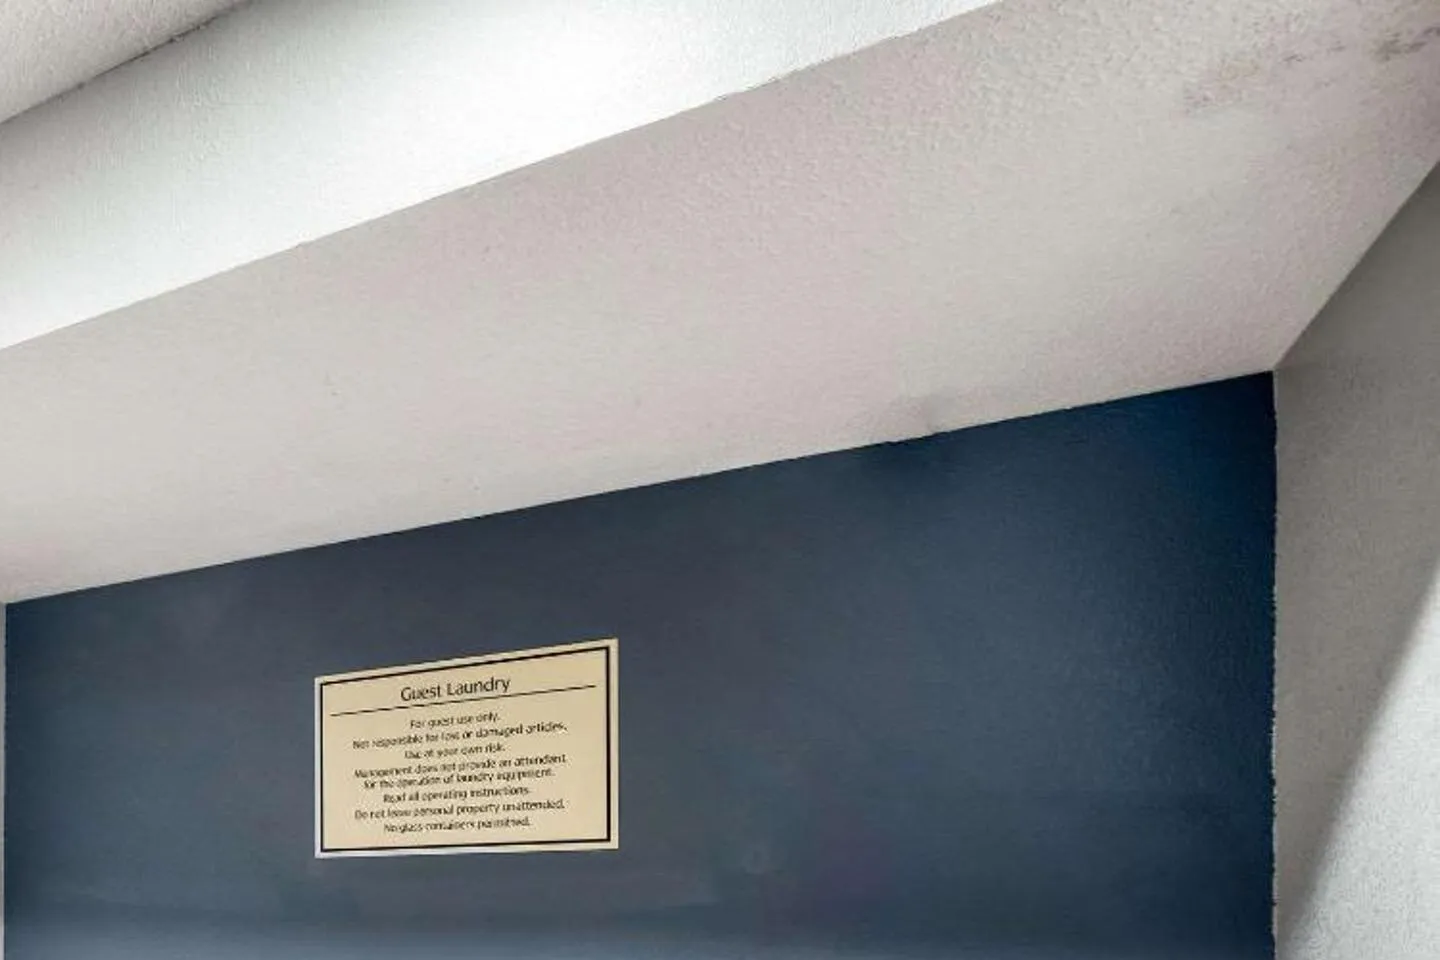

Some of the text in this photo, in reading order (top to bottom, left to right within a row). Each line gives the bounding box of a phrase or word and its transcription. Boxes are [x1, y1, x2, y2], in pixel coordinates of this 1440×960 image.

[400, 676, 511, 701] Guest Laundry
[427, 716, 454, 729] guest
[456, 714, 474, 725] use
[372, 734, 423, 748] responsible
[462, 730, 473, 740] or
[475, 723, 523, 738] damaged
[525, 721, 568, 735] articles.
[436, 746, 459, 758] your
[460, 745, 483, 755] own
[485, 742, 506, 754] risk.
[415, 763, 439, 774] does
[458, 759, 497, 773] provide
[498, 758, 512, 767] an
[514, 754, 567, 767] attendant
[456, 771, 495, 783] laundry
[383, 792, 406, 803] Read
[421, 788, 468, 802] operating
[354, 809, 369, 820] Do
[370, 808, 386, 819] not
[413, 803, 454, 817] personal
[456, 802, 500, 816] property
